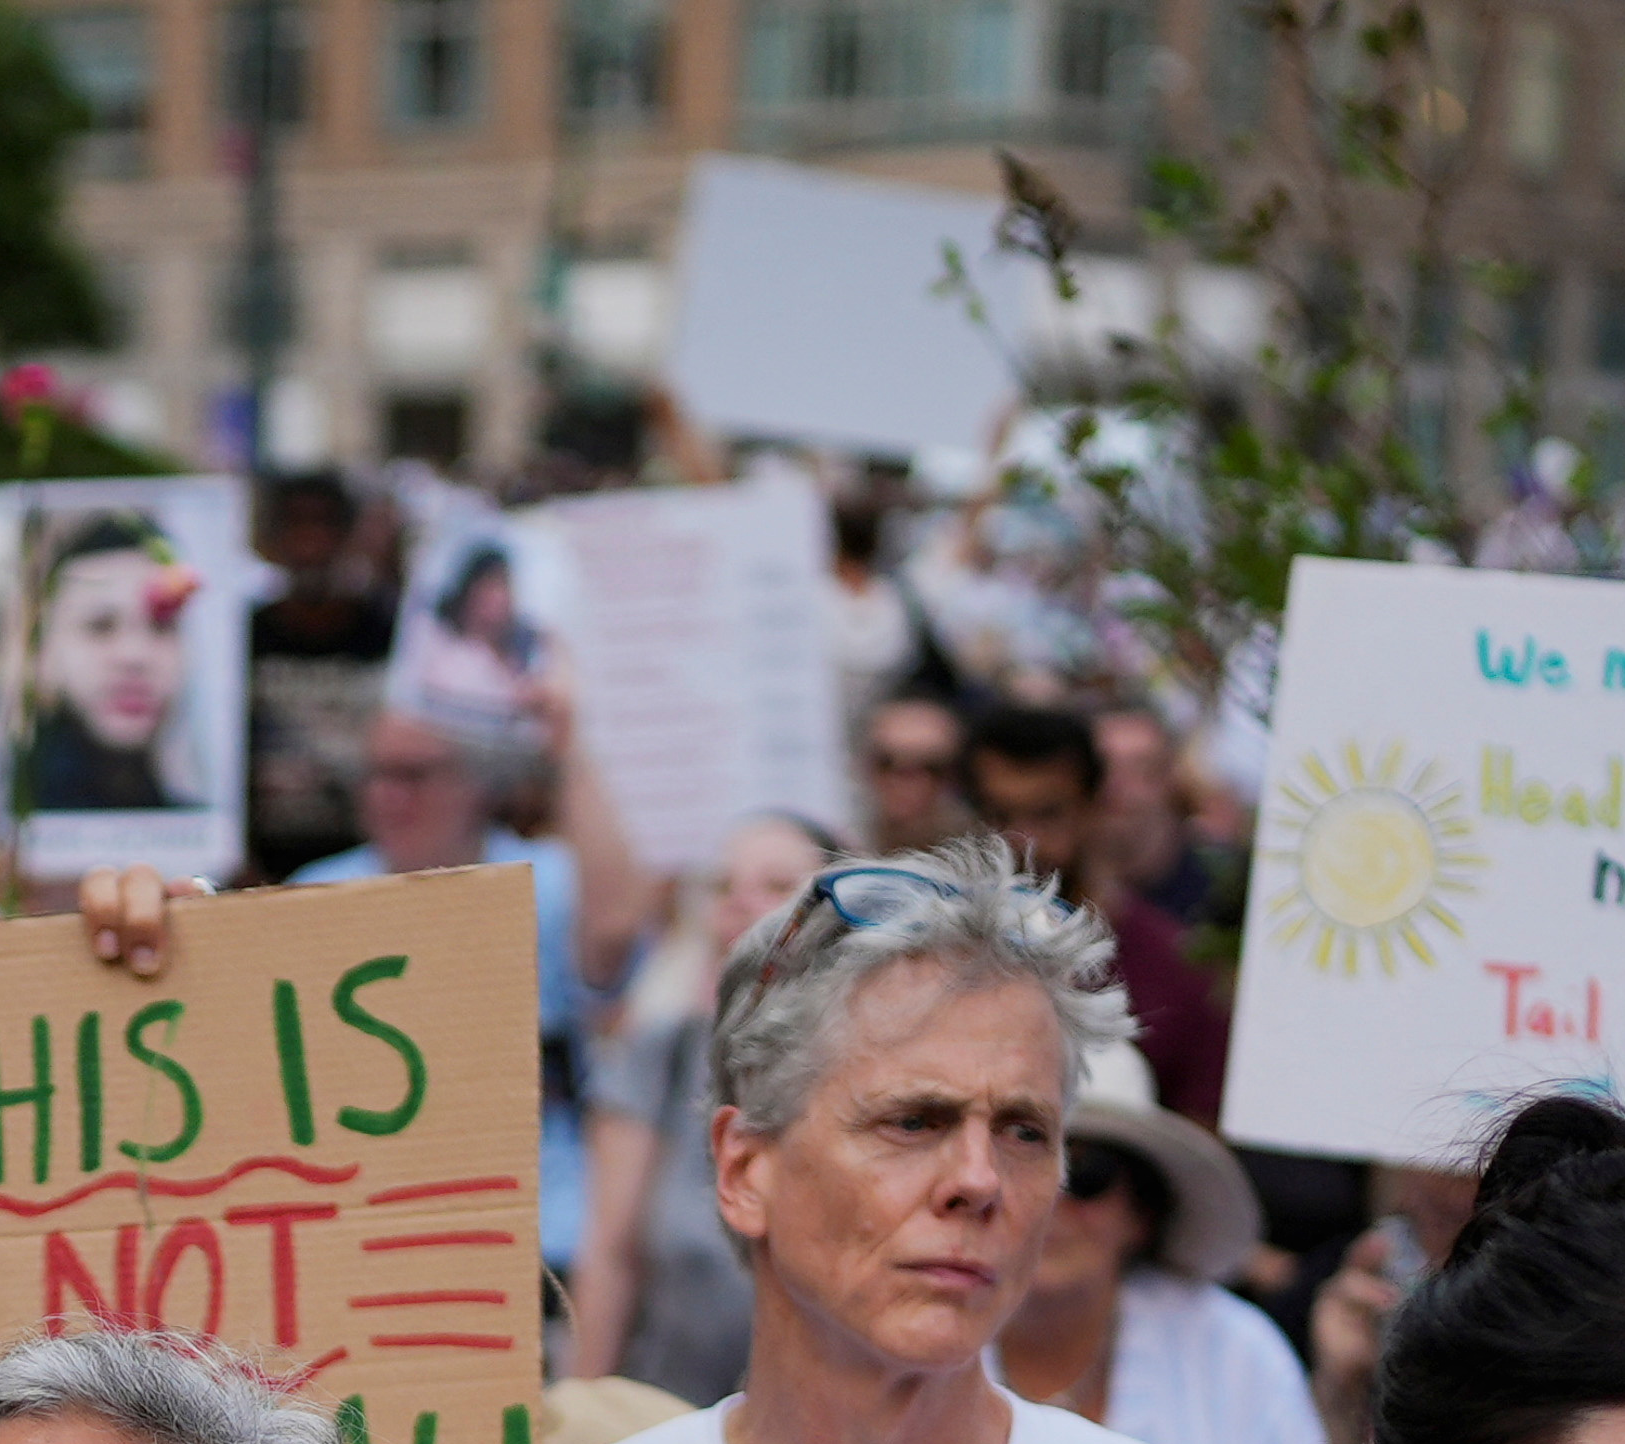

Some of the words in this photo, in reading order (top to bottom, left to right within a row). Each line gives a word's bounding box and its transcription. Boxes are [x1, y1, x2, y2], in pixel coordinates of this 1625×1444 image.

[1475, 626, 1571, 687] We
[272, 954, 427, 1146] IS
[41, 1203, 339, 1357] NOT
